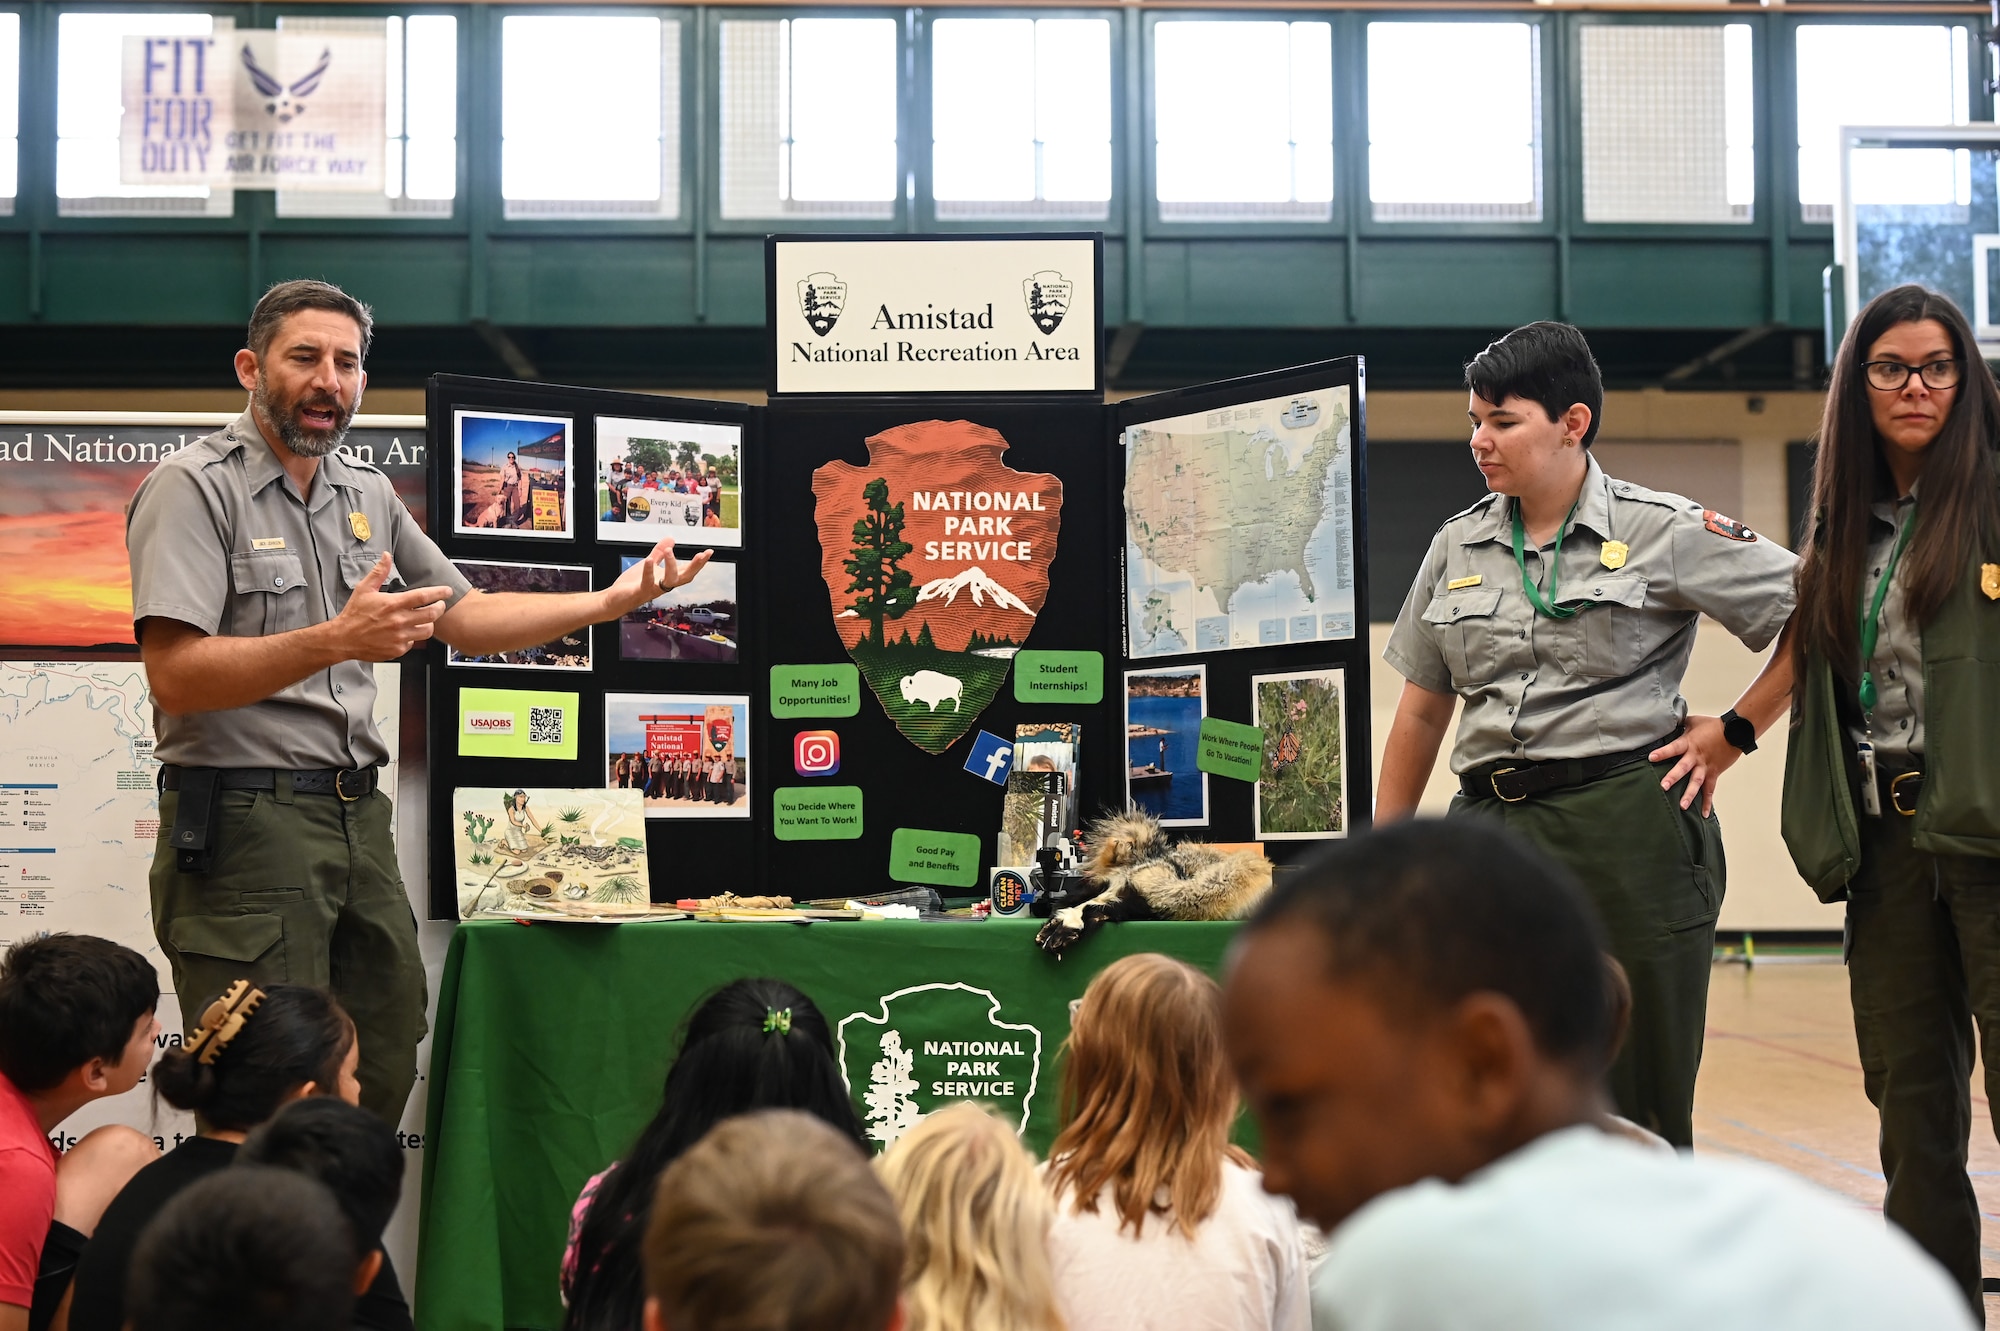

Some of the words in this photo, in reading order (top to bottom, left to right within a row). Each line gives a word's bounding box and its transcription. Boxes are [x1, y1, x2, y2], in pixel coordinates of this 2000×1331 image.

[144, 39, 213, 95] FIT
[143, 98, 212, 140] FOR
[225, 131, 260, 150] GET
[266, 132, 295, 150] FIT
[302, 132, 336, 150] THE
[141, 141, 211, 173] DUTY
[224, 156, 256, 173] AIR
[260, 156, 317, 174] FORCE
[327, 157, 367, 175] WAY
[870, 303, 994, 330] Amistad
[791, 342, 888, 363] National
[896, 341, 1018, 362] Recreation
[1024, 341, 1080, 361] Area
[43, 433, 186, 463] National
[382, 436, 428, 465] Ar
[650, 498, 669, 507] Every
[670, 500, 682, 508] Kid
[913, 491, 1046, 511] NATIONAL
[944, 516, 1013, 536] PARK
[925, 541, 1032, 561] SERVICE
[1039, 664, 1078, 673] Student
[791, 679, 819, 689] Many
[821, 678, 838, 687] Job
[1029, 681, 1088, 693] Internships!
[779, 695, 851, 707] Opportunities!
[470, 719, 512, 730] USAJOBS
[650, 734, 683, 742] Amistad
[650, 742, 684, 750] National
[1201, 733, 1218, 743] Work
[1219, 736, 1239, 748] Where
[1239, 741, 1260, 753] People
[1206, 749, 1214, 757] Go
[1216, 750, 1223, 759] To
[1224, 752, 1252, 766] Vacation!
[780, 803, 796, 811] You
[798, 802, 826, 811] Decide
[827, 802, 856, 810] Where
[1051, 799, 1059, 827] Amistad
[779, 817, 795, 825] You
[796, 817, 819, 825] Want
[820, 816, 830, 824] To
[831, 816, 858, 824] Work!
[916, 846, 938, 855] Good
[940, 848, 955, 858] Pay
[908, 860, 925, 868] and
[926, 861, 960, 871] Benefits
[1007, 879, 1015, 907] DRAIN
[924, 1041, 1025, 1056] NATIONAL
[947, 1061, 1000, 1076] PARK
[932, 1081, 1015, 1096] SERVICE
